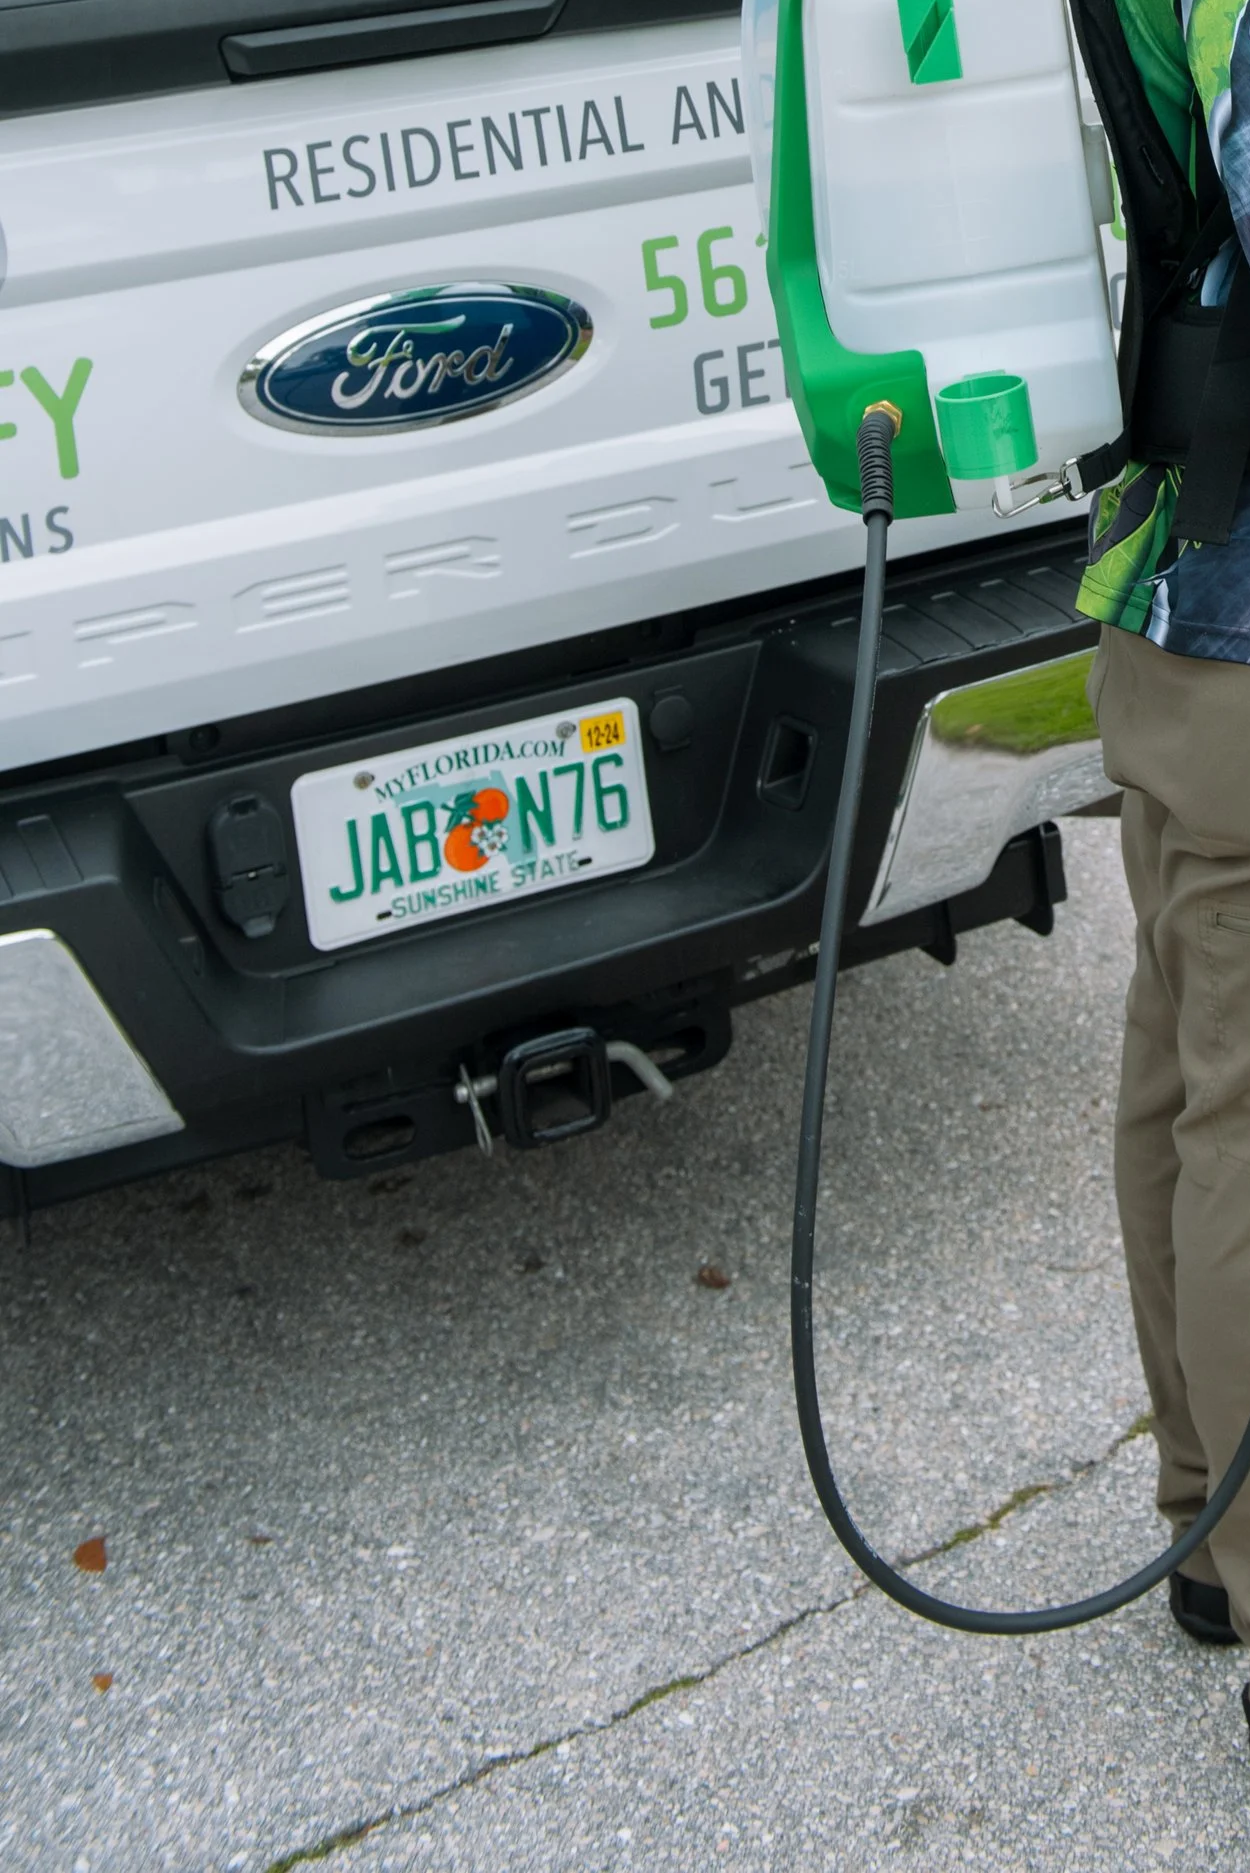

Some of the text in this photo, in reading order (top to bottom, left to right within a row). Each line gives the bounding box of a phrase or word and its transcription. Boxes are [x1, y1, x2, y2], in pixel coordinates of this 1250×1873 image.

[263, 94, 645, 211] RESIDENTIAL
[641, 225, 769, 330] 56
[331, 314, 514, 411] Ford
[374, 738, 566, 803] MYFLORIDA.COM
[587, 721, 620, 748] 12-24
[391, 850, 580, 919] SUNSHINE STATE
